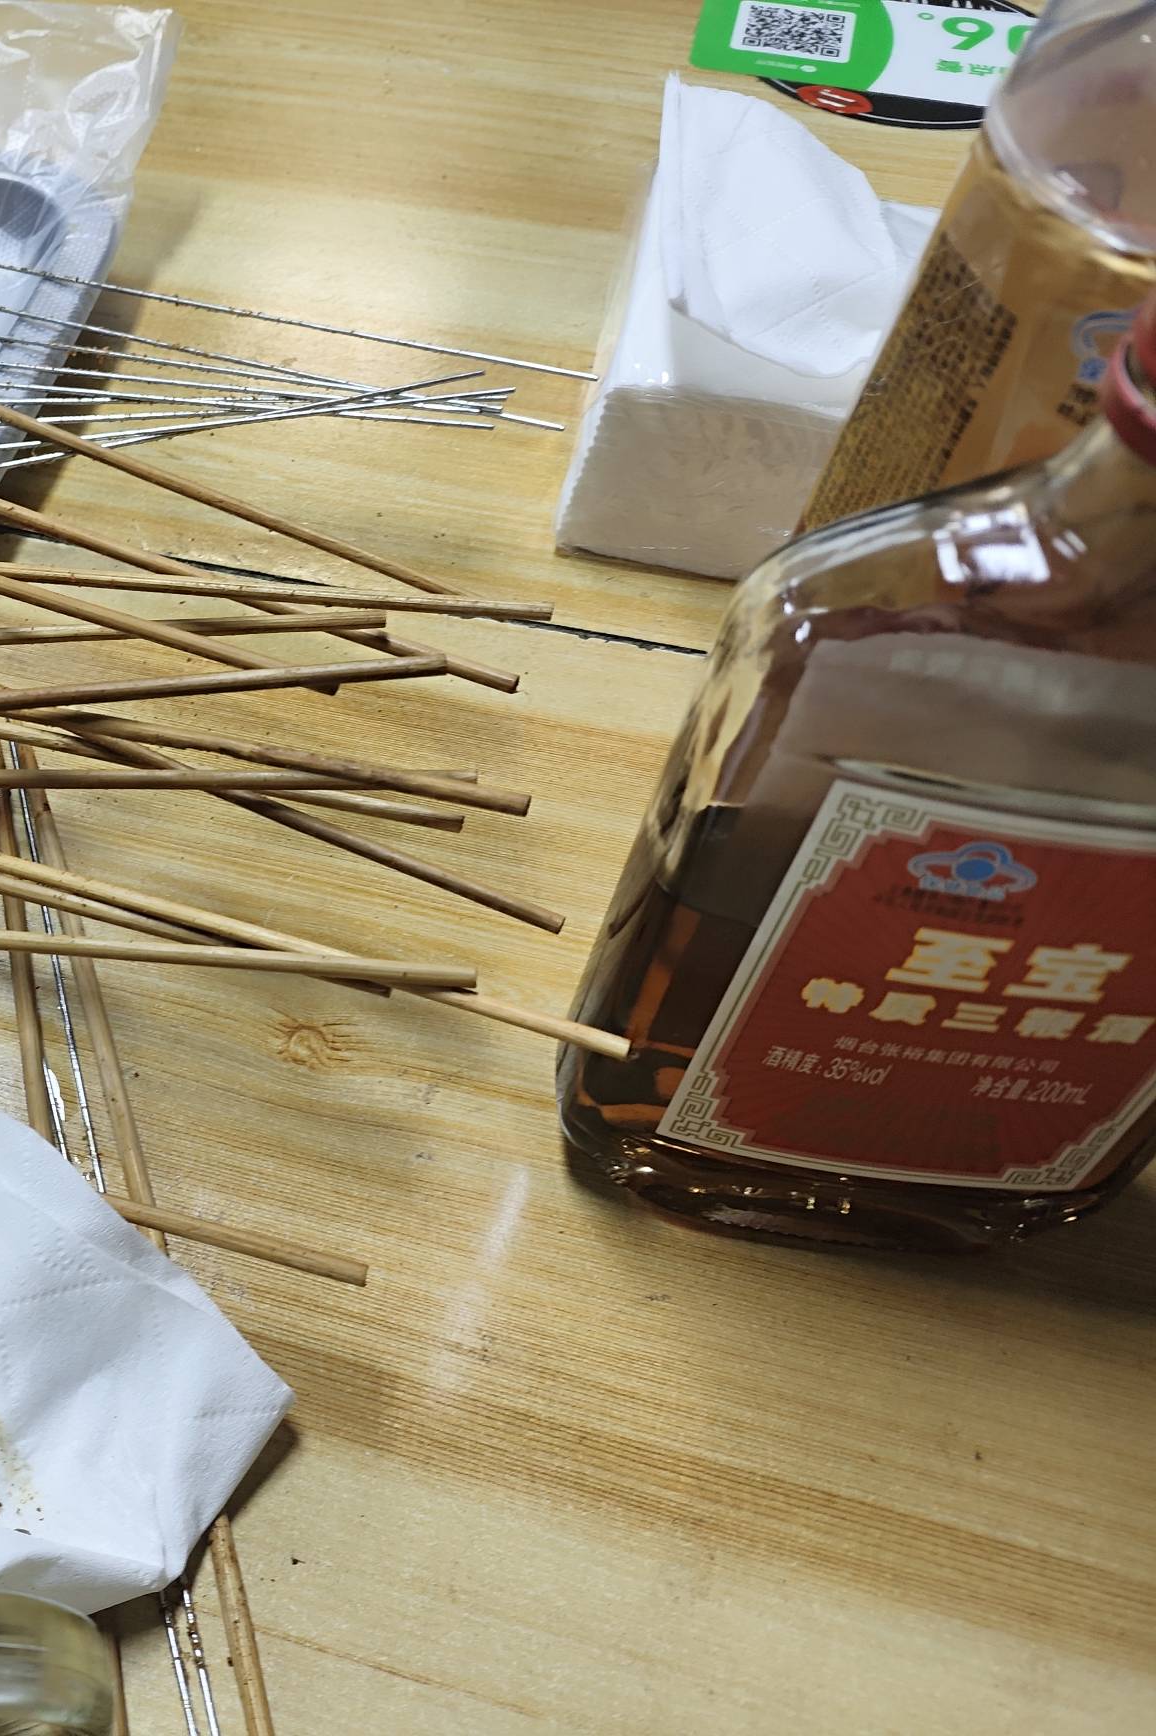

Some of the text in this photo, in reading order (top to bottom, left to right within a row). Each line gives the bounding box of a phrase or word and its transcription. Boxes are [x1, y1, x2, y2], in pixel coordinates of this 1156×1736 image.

[887, 928, 1131, 1002] 至宝
[800, 977, 1156, 1045] 特质三鞭酒
[832, 1036, 1061, 1074] 烟台张裕集团有限公司
